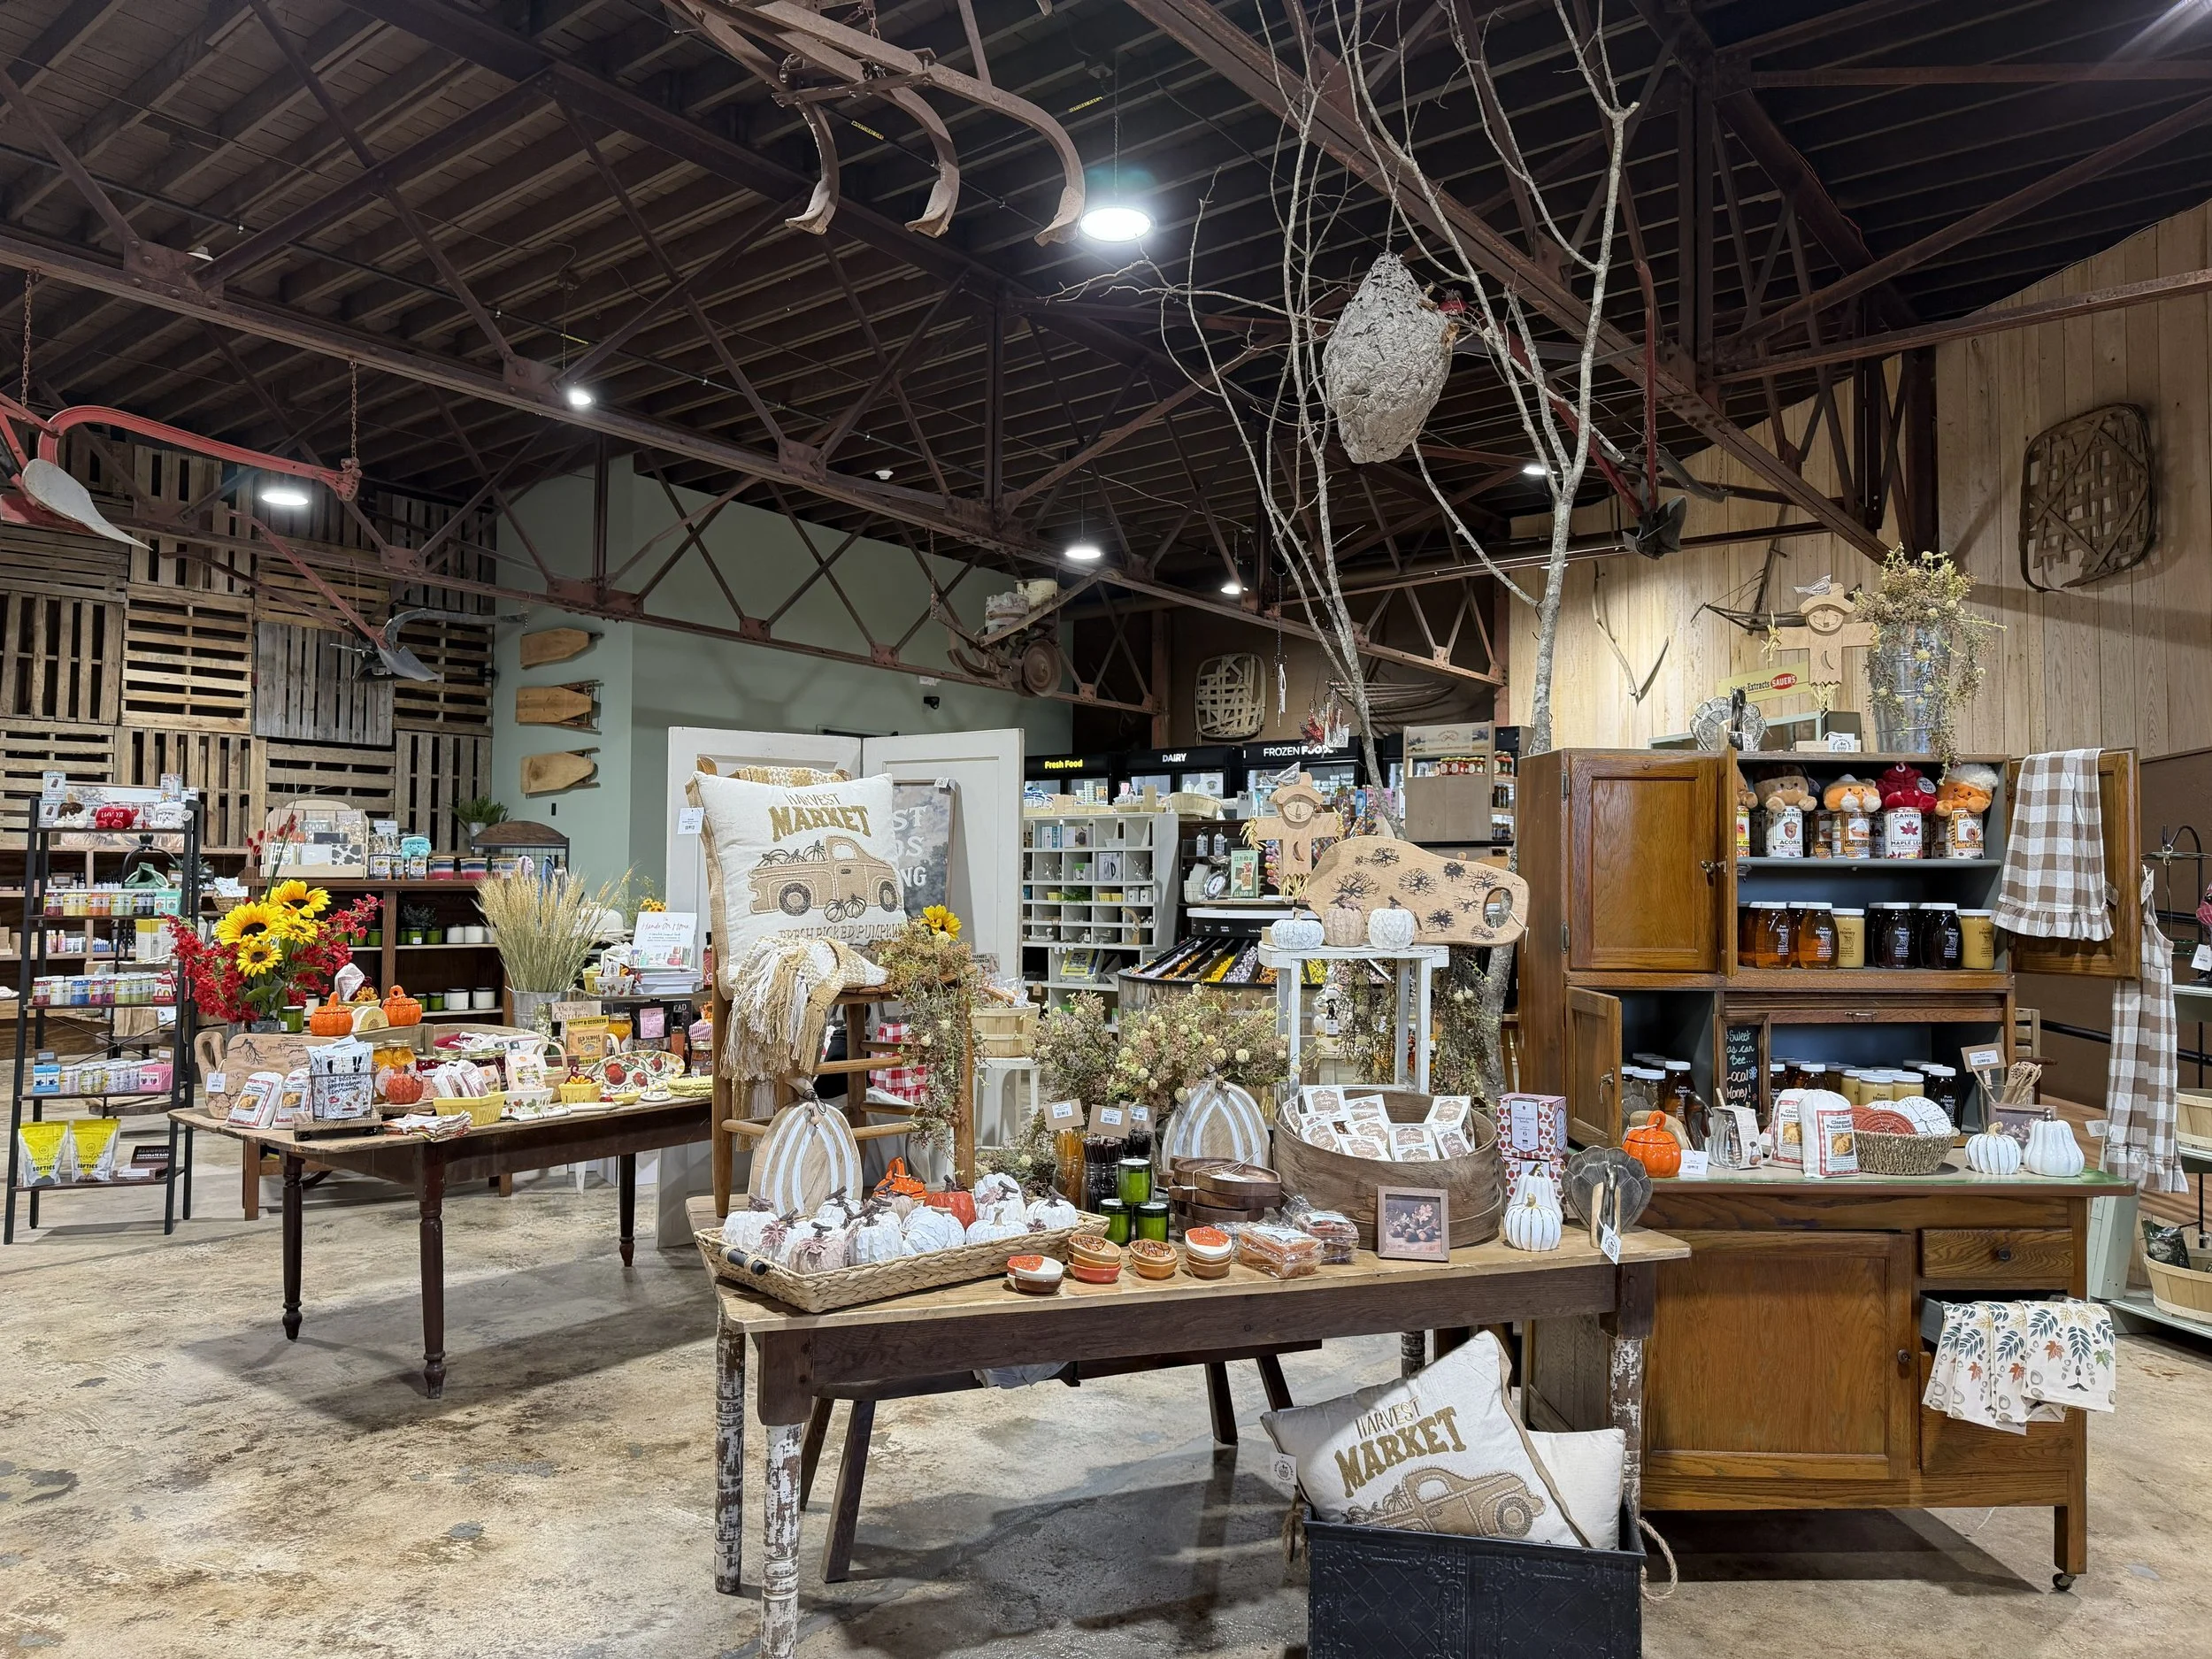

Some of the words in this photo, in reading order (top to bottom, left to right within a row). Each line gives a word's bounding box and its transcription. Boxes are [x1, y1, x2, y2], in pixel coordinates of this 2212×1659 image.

[1771, 675, 1796, 687] SAUER'S
[1263, 746, 1300, 757] FROZEN
[1044, 760, 1064, 769] Fresh
[1064, 759, 1083, 768] Food
[1162, 753, 1187, 763] DAIRY
[784, 793, 841, 805] HARVEST
[768, 805, 872, 842] MARKET
[1730, 1030, 1751, 1042] Sweet
[1355, 1397, 1421, 1440] HARVEST
[1334, 1406, 1467, 1498] MARKET
